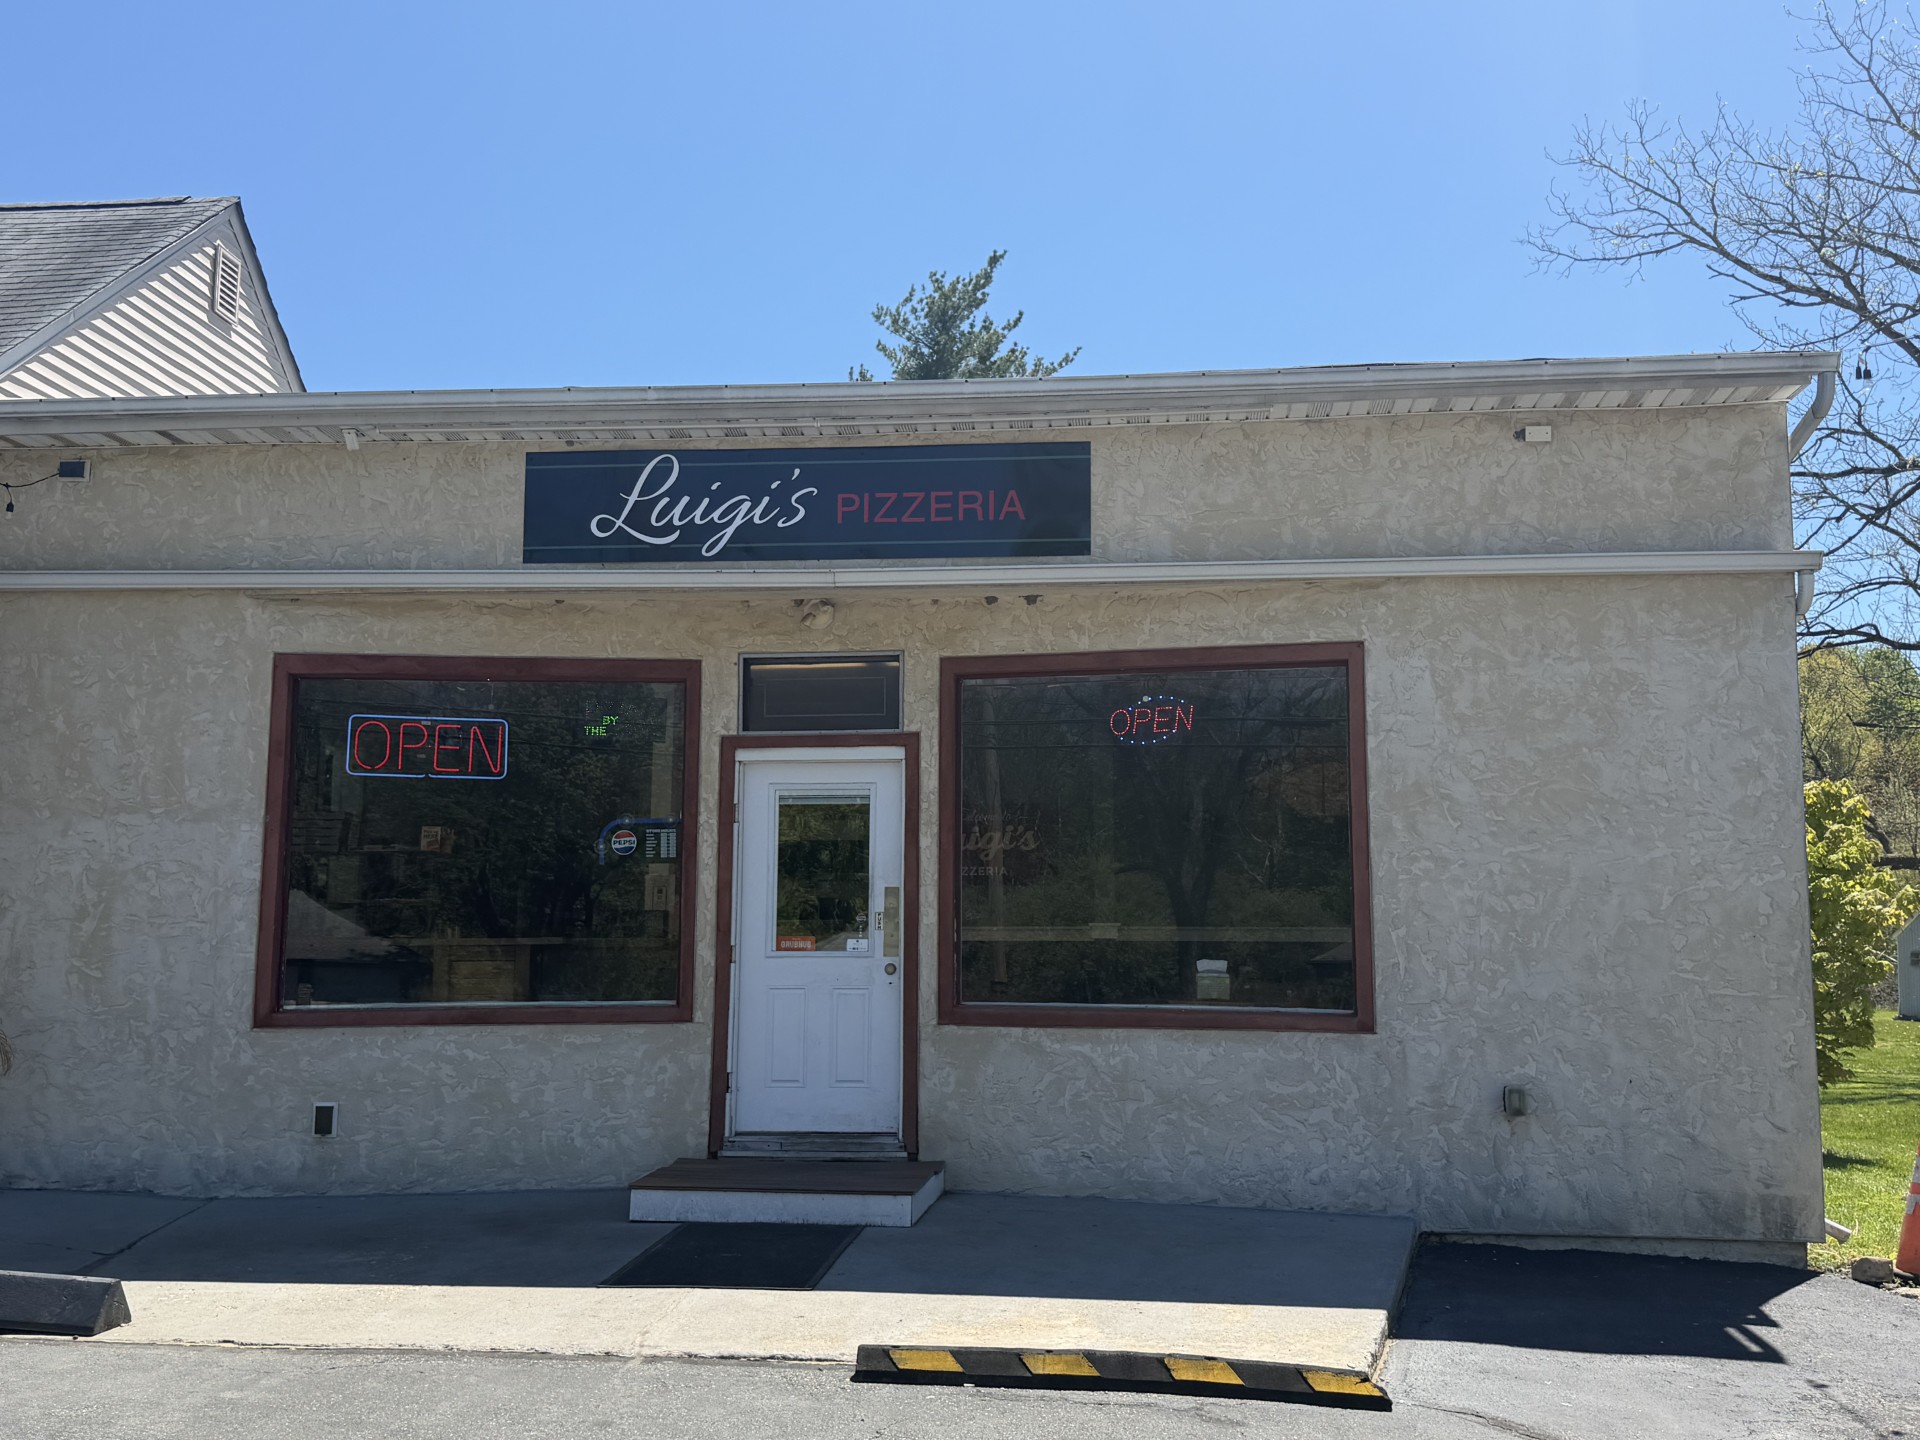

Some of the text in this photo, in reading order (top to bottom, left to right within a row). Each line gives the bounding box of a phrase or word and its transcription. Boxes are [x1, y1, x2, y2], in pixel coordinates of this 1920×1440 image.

[590, 453, 1026, 557] Luigi's PIZZERIA
[584, 726, 607, 736] THE
[602, 715, 619, 725] BY
[1109, 703, 1195, 737] OPEN
[354, 720, 503, 774] OPEN
